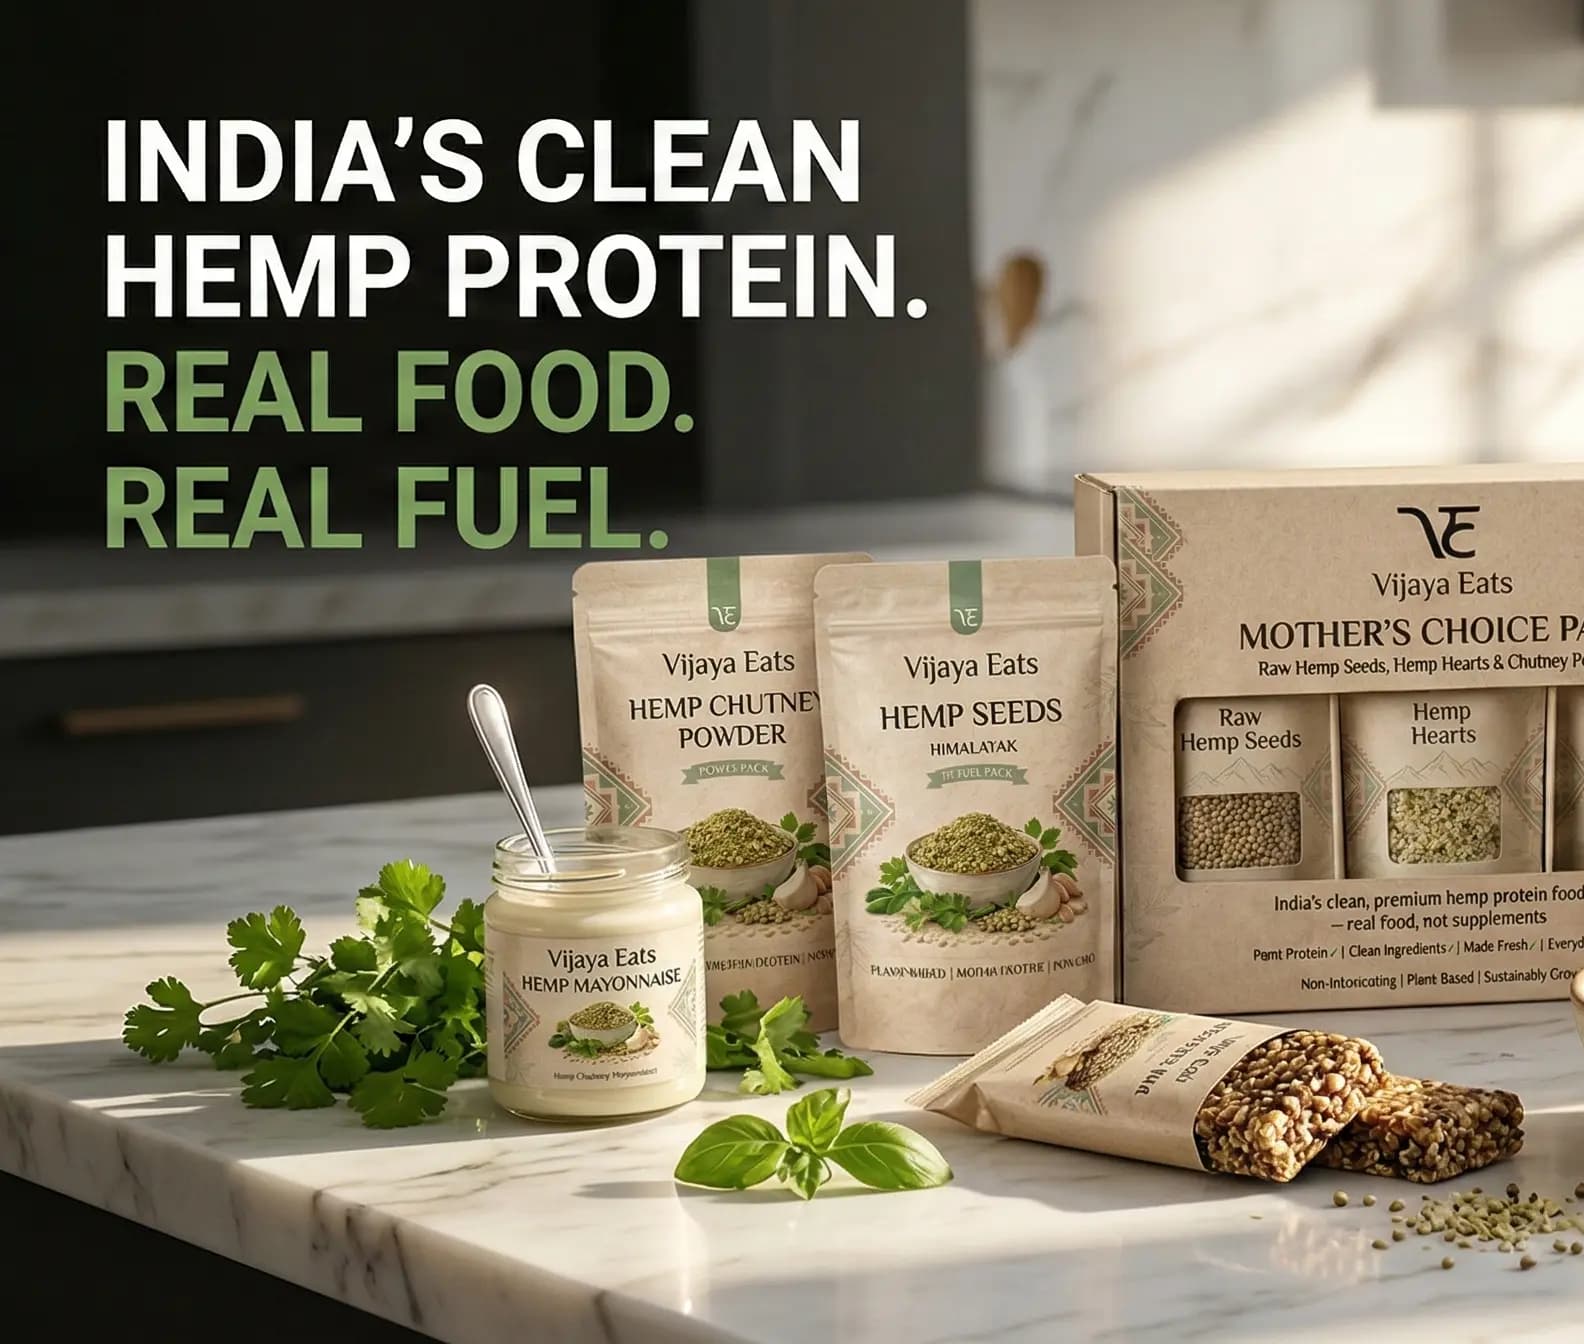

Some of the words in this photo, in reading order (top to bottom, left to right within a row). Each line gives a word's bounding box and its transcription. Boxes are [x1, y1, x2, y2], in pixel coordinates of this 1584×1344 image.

[1372, 572, 1450, 602] Vijaya
[1459, 570, 1514, 596] Eats
[1421, 615, 1549, 646] CHOICE
[662, 651, 736, 682] Vijaya
[743, 650, 796, 674] Eats
[903, 655, 977, 685] Vijaya
[987, 653, 1039, 676] Eats
[1258, 660, 1292, 677] Raw
[1295, 658, 1340, 679] Hemp
[1343, 657, 1390, 676] Seeds,
[1393, 656, 1438, 675] Hemp
[1441, 654, 1490, 672] Hearts
[1493, 655, 1504, 670] &
[1507, 653, 1568, 673] Chutney
[628, 696, 702, 721] HEMP
[879, 704, 963, 730] HEMP
[971, 698, 1063, 725] SEEDS
[1218, 708, 1262, 727] Raw
[1413, 702, 1472, 726] Hemp
[678, 723, 786, 750] POWDER
[1180, 733, 1241, 755] Hemp
[1244, 730, 1302, 751] Seeds
[1411, 725, 1477, 747] Hearts
[957, 768, 982, 779] FUEL
[984, 767, 1013, 779] PACK
[1326, 892, 1371, 912] clean,
[1373, 892, 1442, 911] premium
[1445, 888, 1489, 909] hemp
[1493, 886, 1548, 907] protein
[1346, 914, 1376, 932] real
[1380, 913, 1420, 932] food,
[1422, 913, 1449, 929] not
[1451, 908, 1548, 929] supplements
[547, 949, 609, 973] Vijaya
[614, 948, 657, 967] Eats
[1285, 946, 1328, 960] Protein
[1349, 944, 1382, 958] Clean
[1383, 942, 1447, 960] Ingredients
[1463, 939, 1494, 954] Made
[1496, 938, 1529, 953] Fresh
[521, 975, 569, 993] HEMP
[573, 967, 681, 993] MAYONNAISE
[1406, 972, 1438, 986] Plant
[1440, 970, 1475, 985] Based
[1483, 967, 1547, 985] Sustainably
[1549, 966, 1578, 981] Gro
